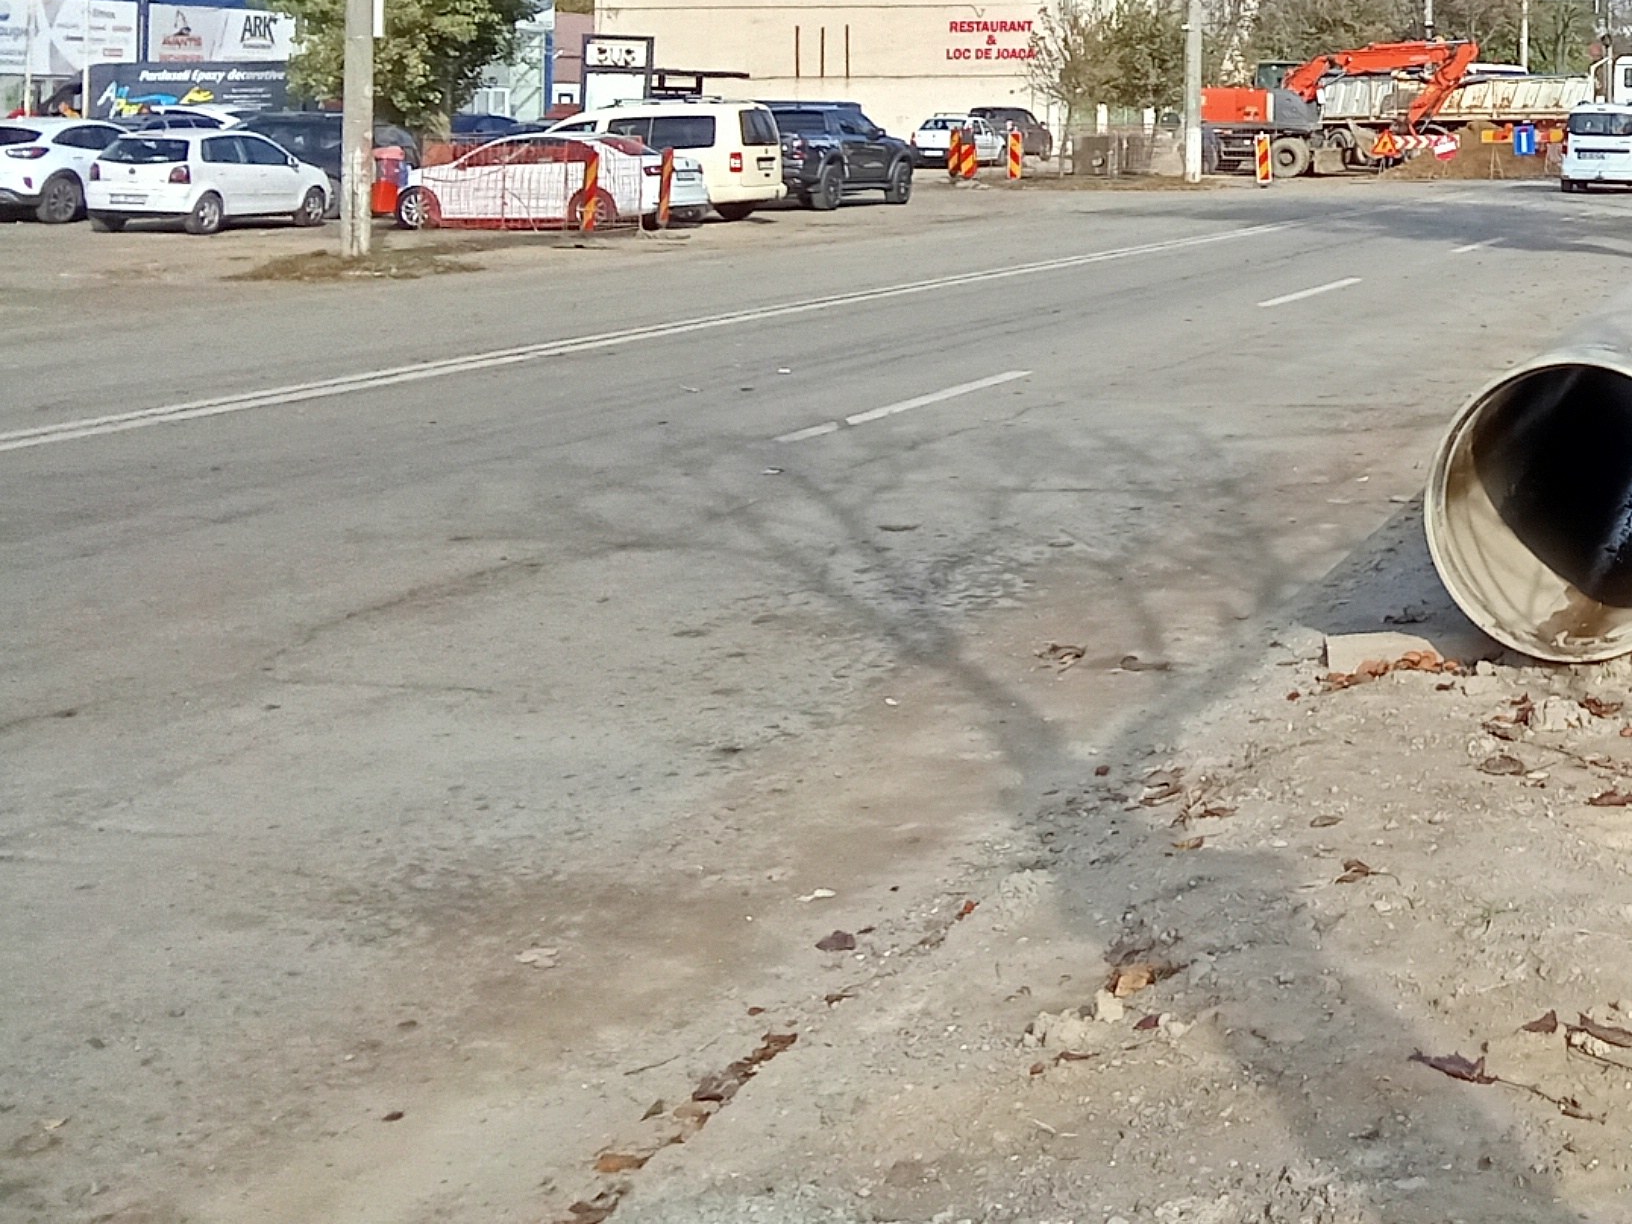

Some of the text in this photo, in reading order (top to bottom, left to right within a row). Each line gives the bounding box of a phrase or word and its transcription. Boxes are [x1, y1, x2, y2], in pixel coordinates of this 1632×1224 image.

[240, 15, 276, 44] ARK
[949, 21, 1033, 33] RESTAURANT
[986, 34, 997, 46] &
[946, 48, 971, 60] LOC
[975, 48, 992, 60] DE
[190, 70, 226, 85] Epoxy
